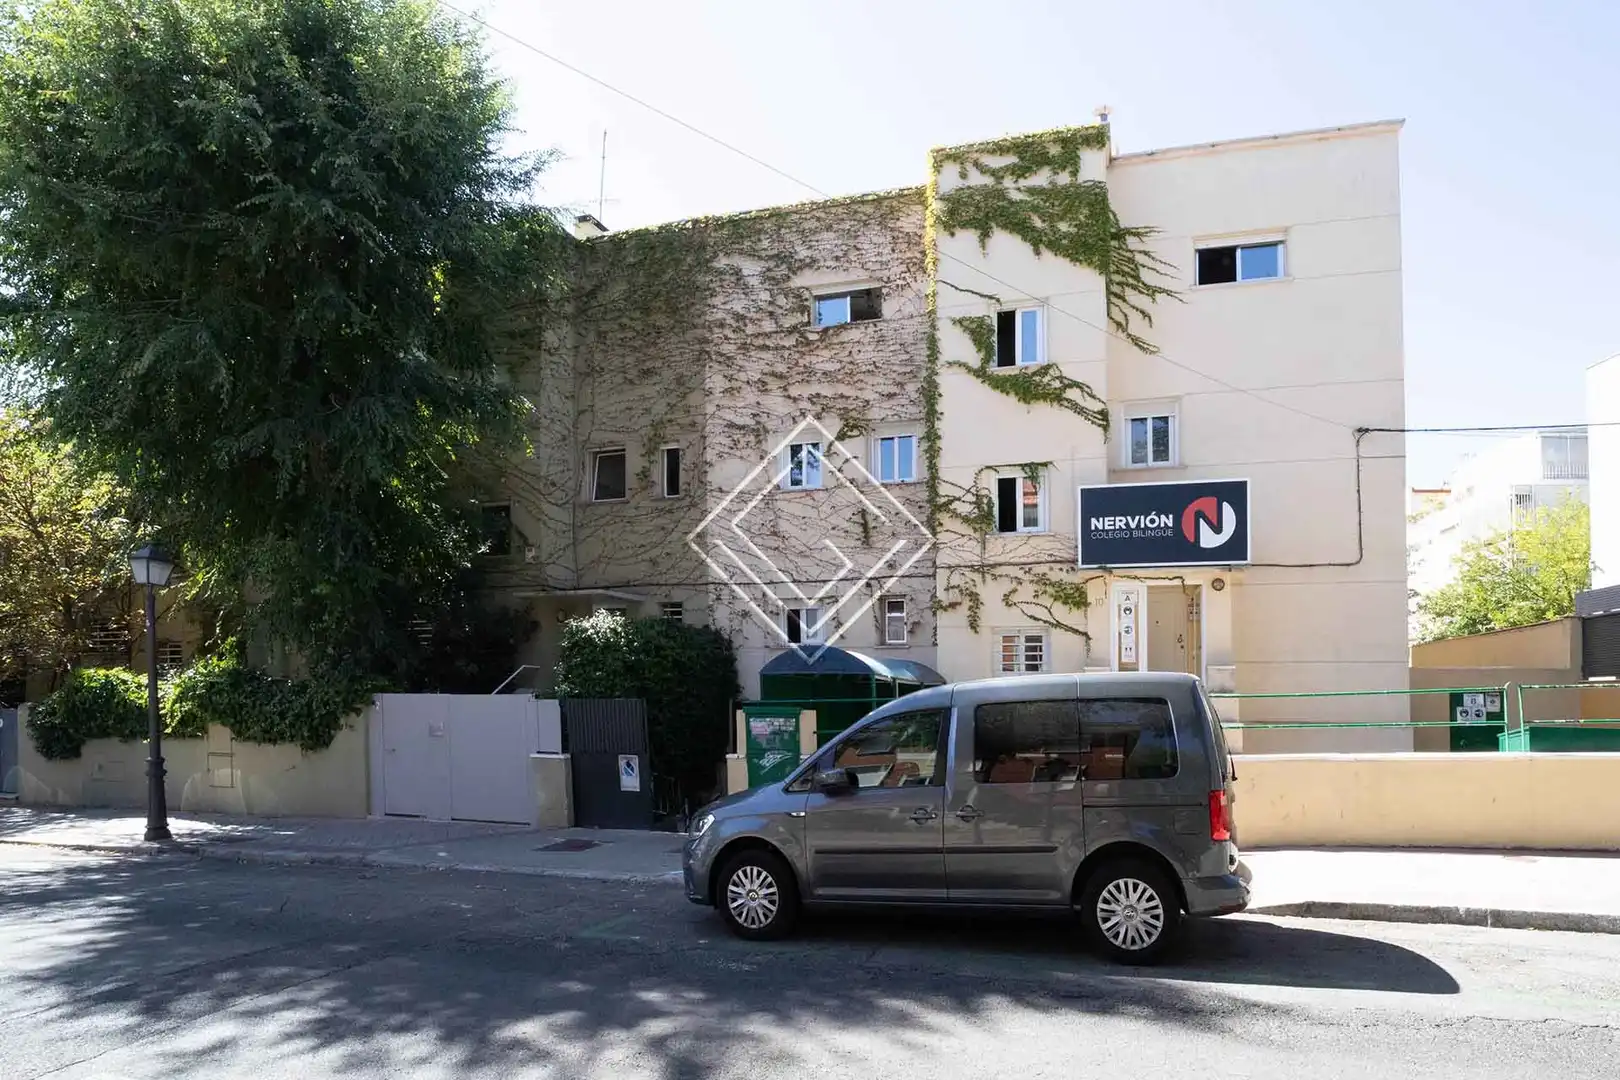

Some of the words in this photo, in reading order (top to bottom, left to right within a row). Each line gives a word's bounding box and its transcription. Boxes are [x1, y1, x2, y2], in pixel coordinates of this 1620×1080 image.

[1091, 511, 1173, 530] NERVIÓN
[1091, 529, 1130, 539] COLEGIO
[1133, 528, 1173, 538] BILINGÜE
